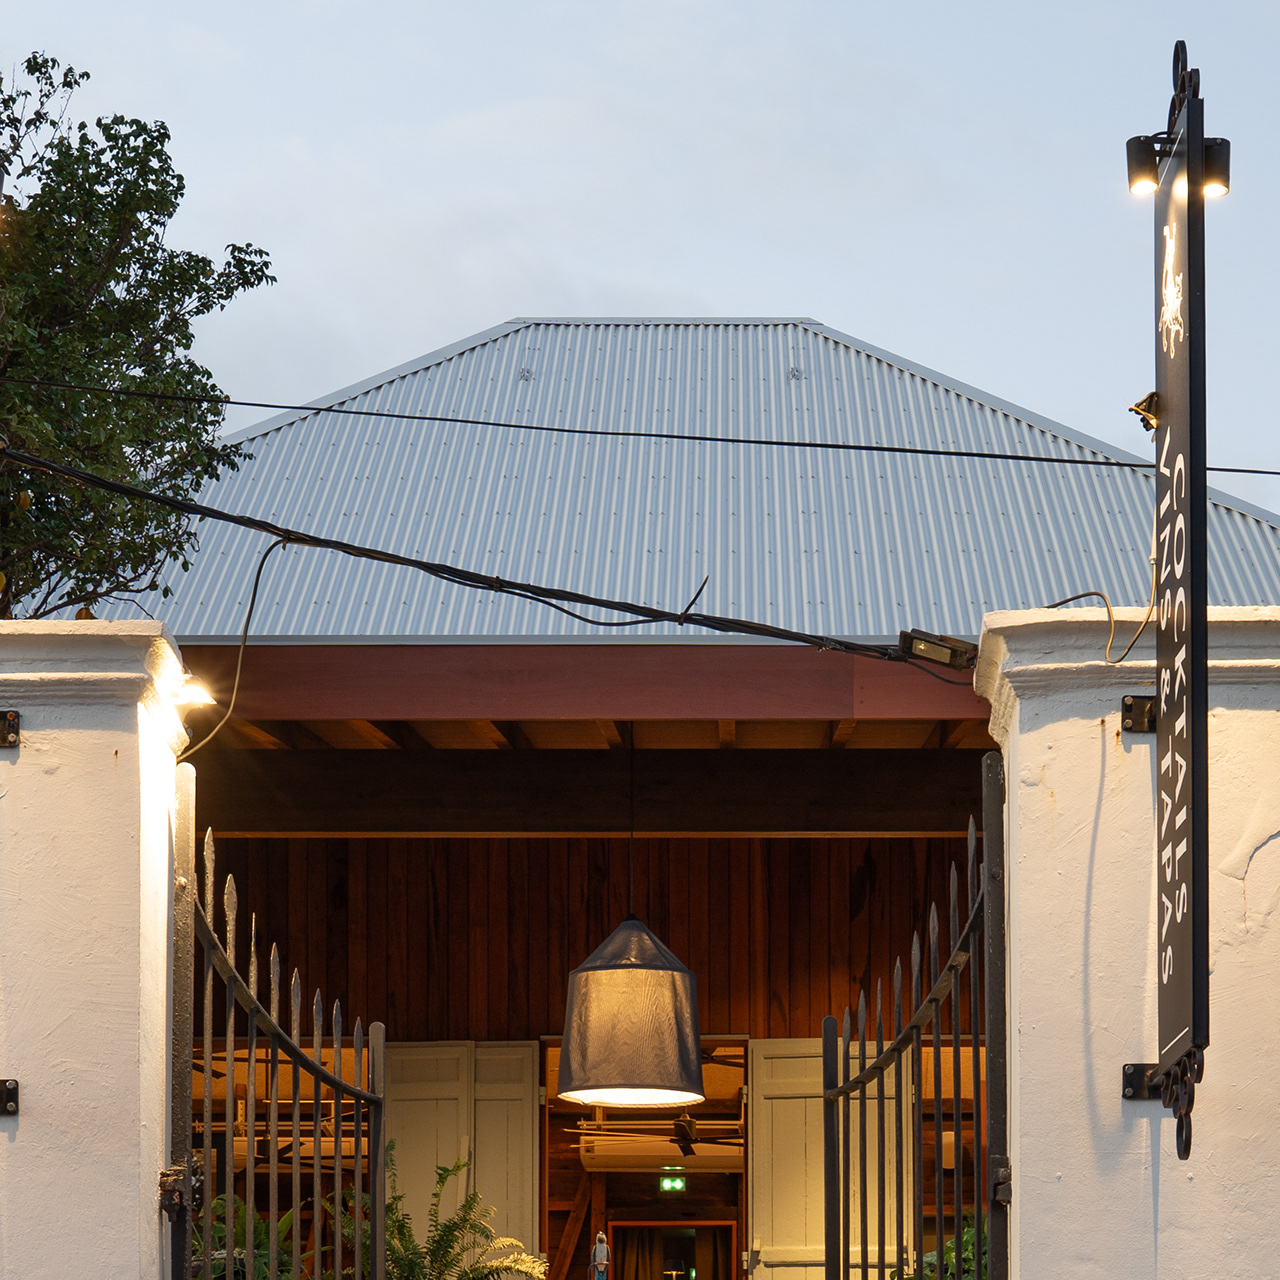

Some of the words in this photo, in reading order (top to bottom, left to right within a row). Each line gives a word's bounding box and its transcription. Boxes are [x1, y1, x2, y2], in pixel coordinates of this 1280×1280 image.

[1158, 426, 1172, 632] VINS
[1159, 667, 1172, 716] &
[1173, 452, 1190, 925] COCKTAILS
[1159, 736, 1174, 985] TAPAS
